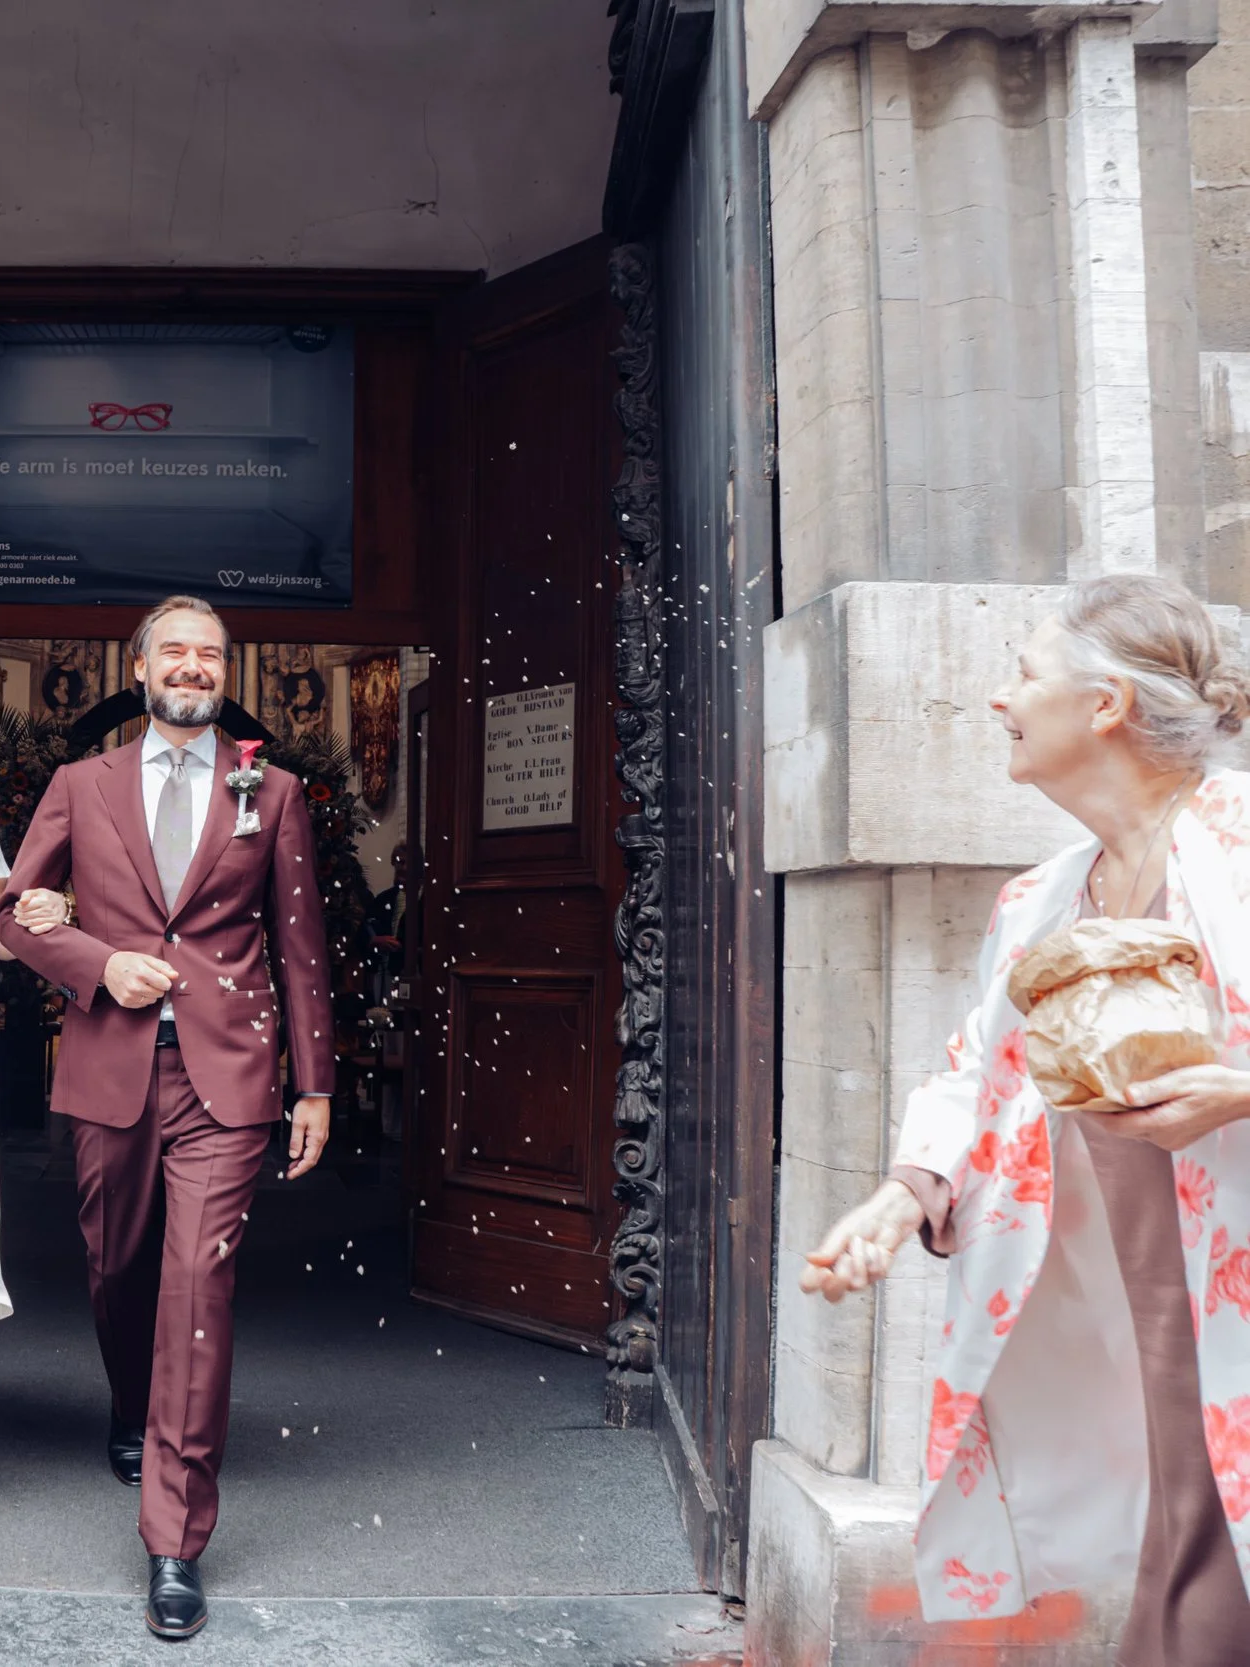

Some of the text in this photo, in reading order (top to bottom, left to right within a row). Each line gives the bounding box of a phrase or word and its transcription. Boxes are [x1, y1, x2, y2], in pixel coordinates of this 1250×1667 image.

[18, 461, 55, 475] arm
[62, 457, 77, 475] is
[85, 459, 135, 475] moet
[141, 457, 209, 477] keuzes
[215, 459, 288, 478] maken.
[247, 573, 322, 589] welzijnszorg
[488, 697, 506, 708] erk
[559, 687, 573, 695] van
[491, 706, 518, 718] GOEDE
[487, 729, 512, 741] Eglise
[487, 731, 573, 752] de BON SECOURS
[487, 762, 513, 774] Kirche
[505, 766, 566, 782] GUTER HILFE
[486, 795, 515, 806] Church
[557, 789, 567, 799] of
[505, 801, 563, 816] GOOD HELP
